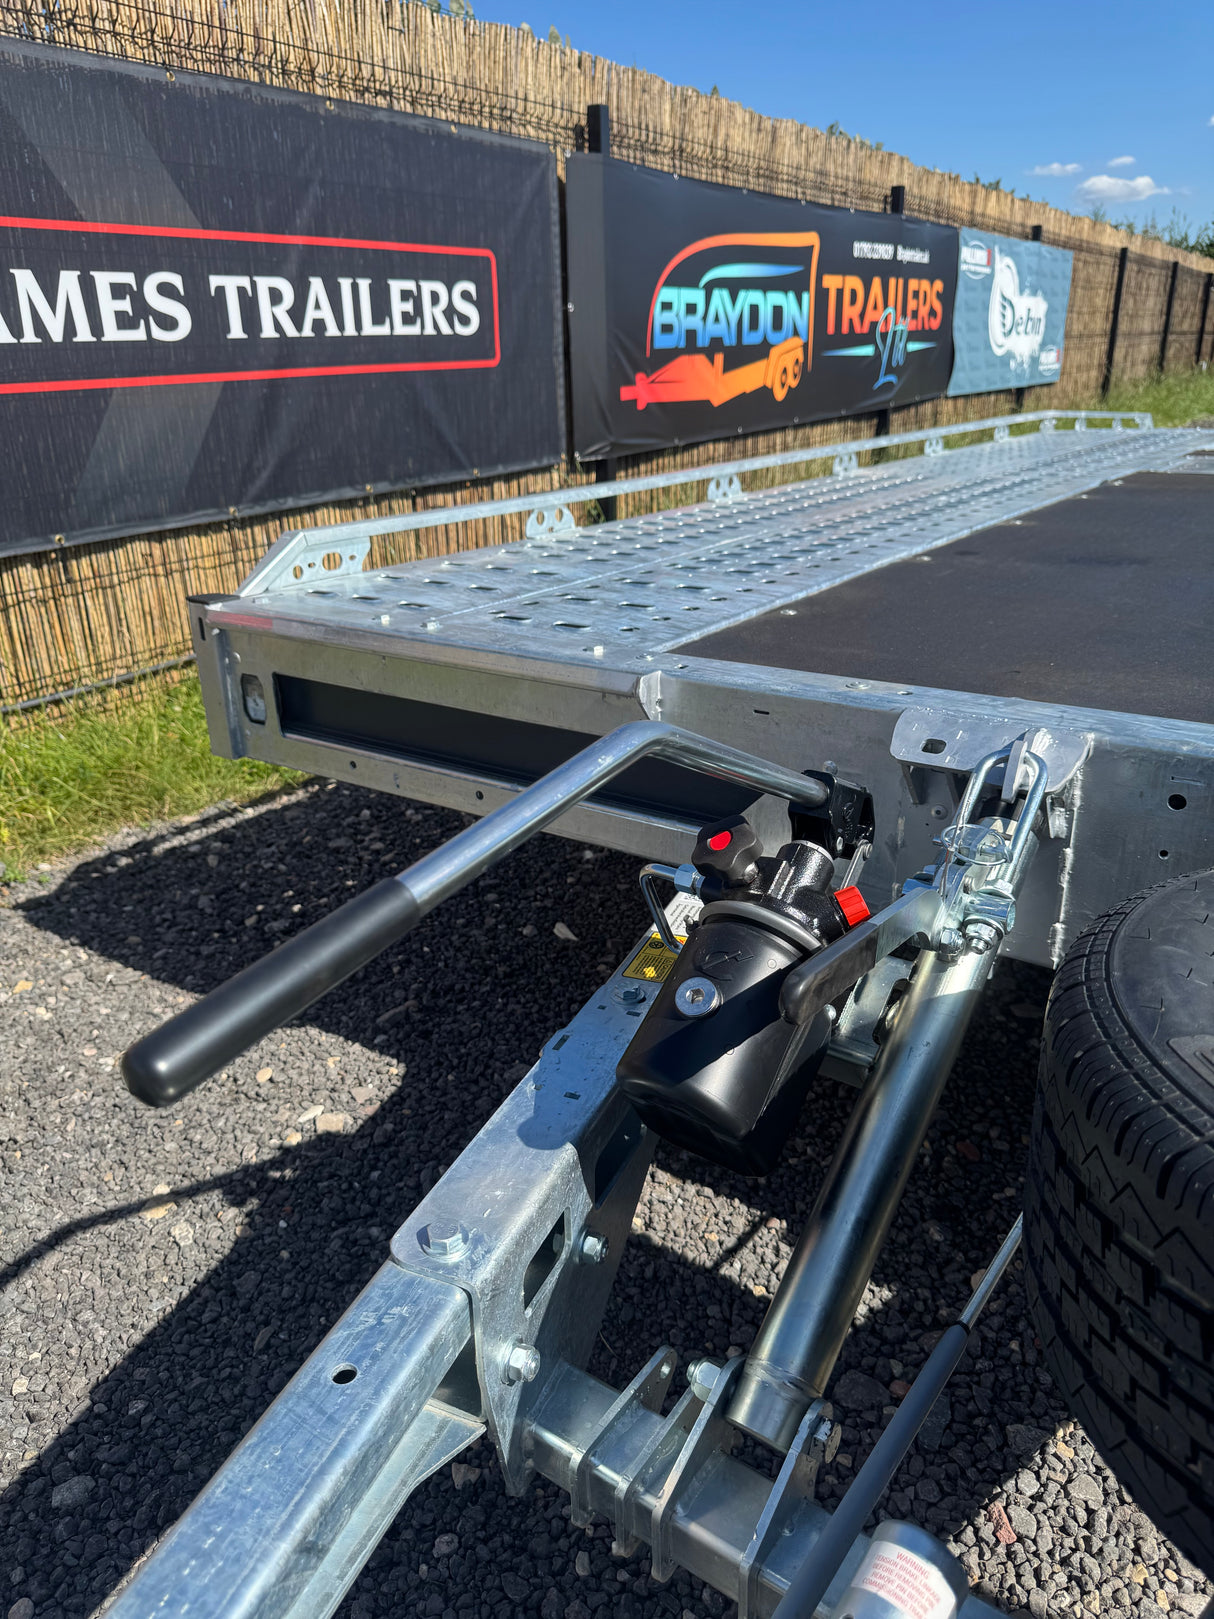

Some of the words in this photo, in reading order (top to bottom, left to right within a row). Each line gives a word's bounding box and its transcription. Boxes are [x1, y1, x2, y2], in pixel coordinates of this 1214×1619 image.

[0, 268, 192, 343] MES
[209, 274, 480, 339] TRAILERS
[653, 286, 810, 349] BRAYDON
[822, 274, 944, 335] TRAILERS
[896, 1552, 930, 1580] WARNING
